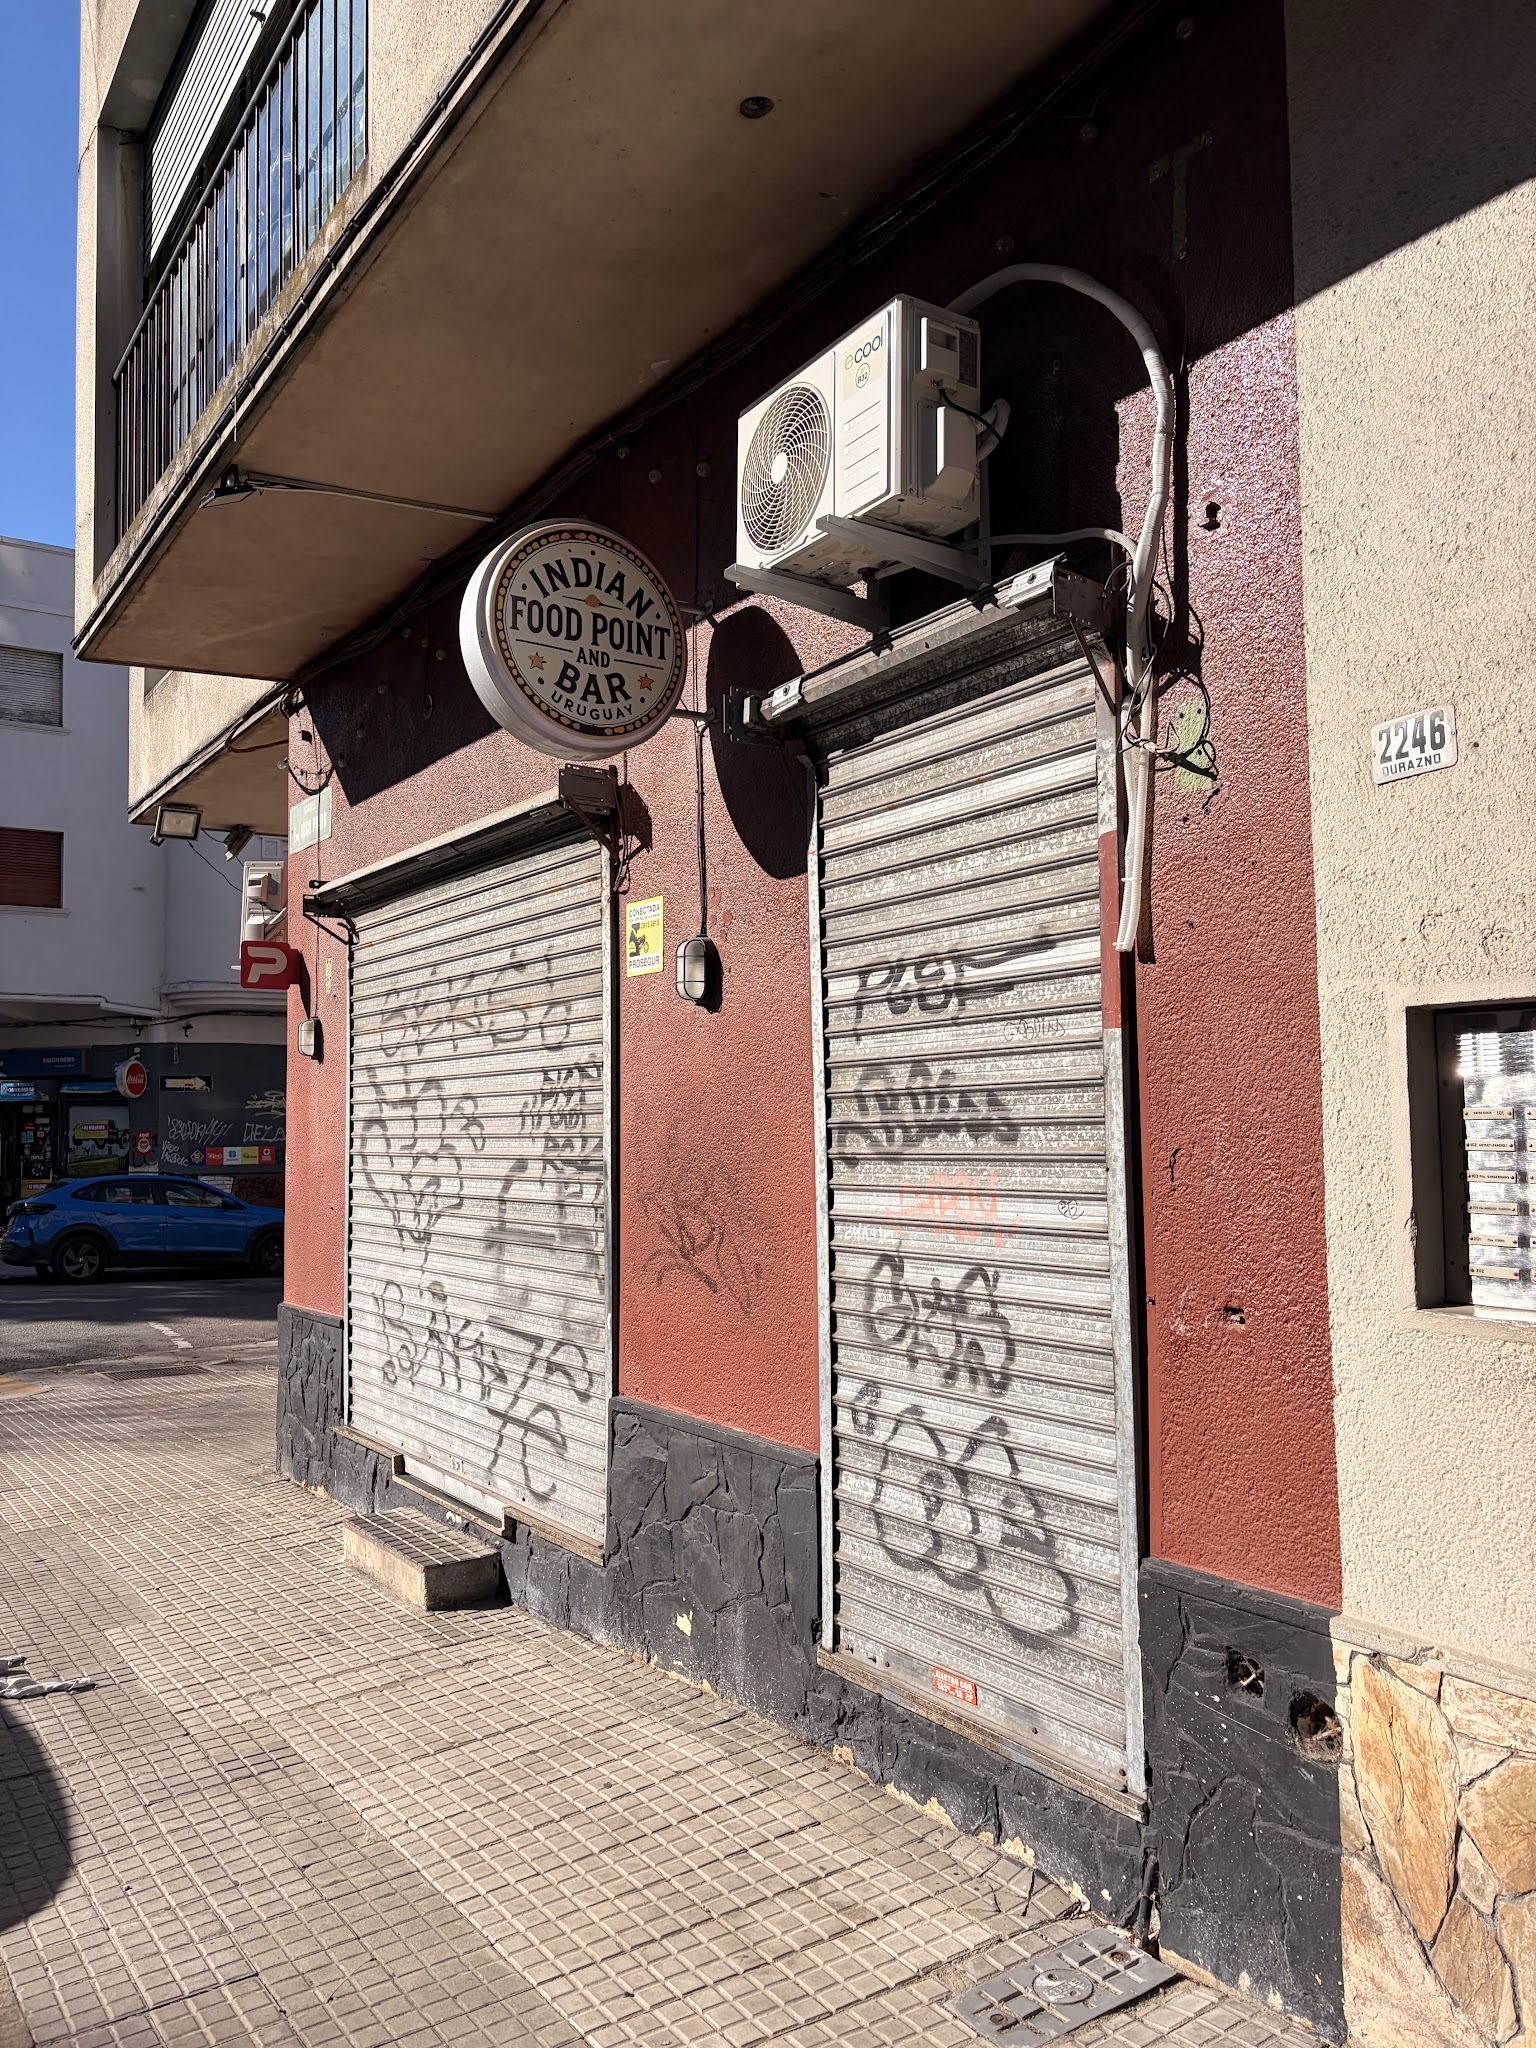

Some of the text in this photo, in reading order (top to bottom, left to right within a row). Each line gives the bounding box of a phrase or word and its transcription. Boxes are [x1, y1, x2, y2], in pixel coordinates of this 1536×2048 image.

[857, 371, 869, 384] R32
[528, 557, 656, 620] INDIAN
[509, 594, 671, 661] FOOD POINT
[576, 647, 611, 668] AND
[553, 660, 633, 705] BAR
[551, 690, 633, 721] URUGUAY
[1378, 709, 1446, 765] 2246
[1381, 753, 1441, 777] DURAZNO
[628, 903, 660, 918] CONECTADA
[628, 955, 660, 970] PROSEGUR
[126, 1073, 145, 1086] Coca-Cola
